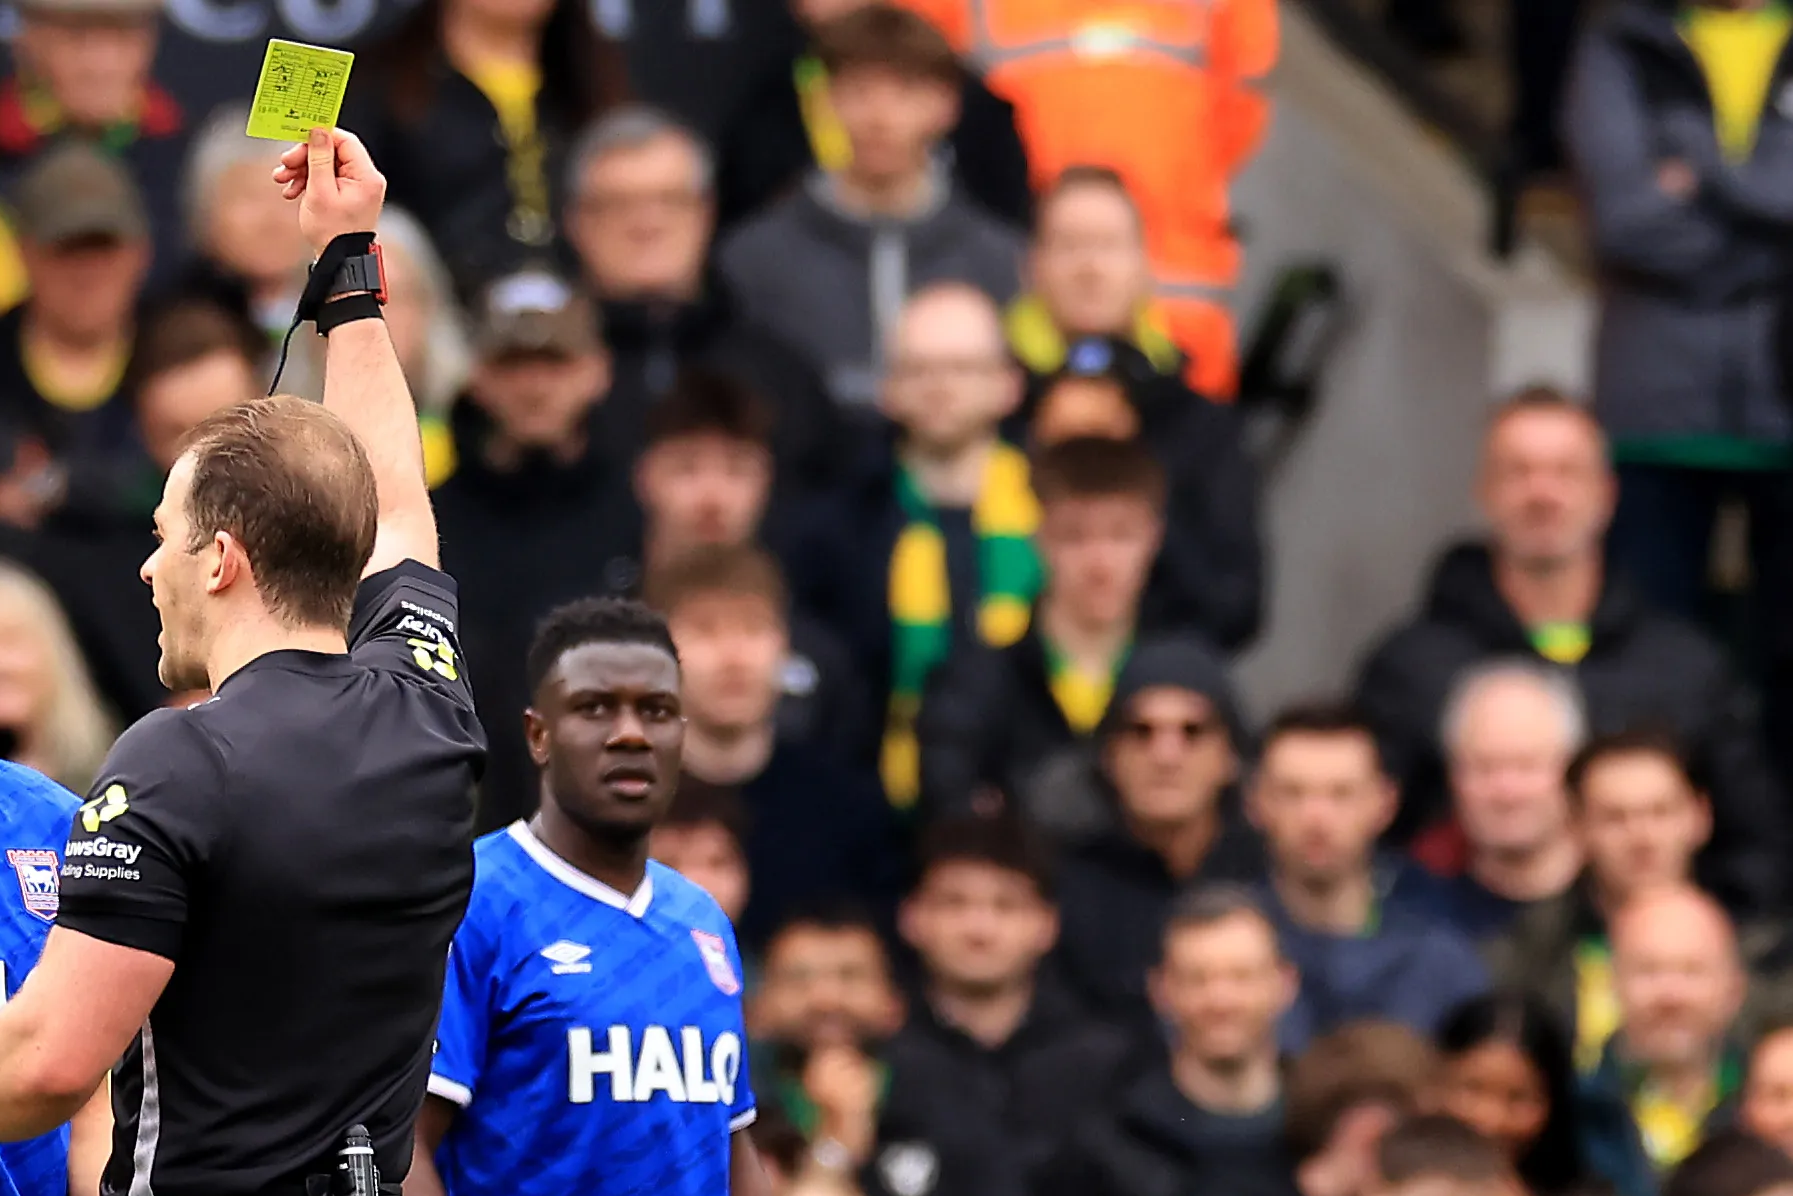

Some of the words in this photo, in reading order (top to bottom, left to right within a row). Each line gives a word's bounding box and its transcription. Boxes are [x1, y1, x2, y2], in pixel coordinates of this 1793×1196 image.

[65, 837, 142, 864] uwsGray
[84, 863, 140, 880] Supplies
[568, 1024, 740, 1106] HALO
